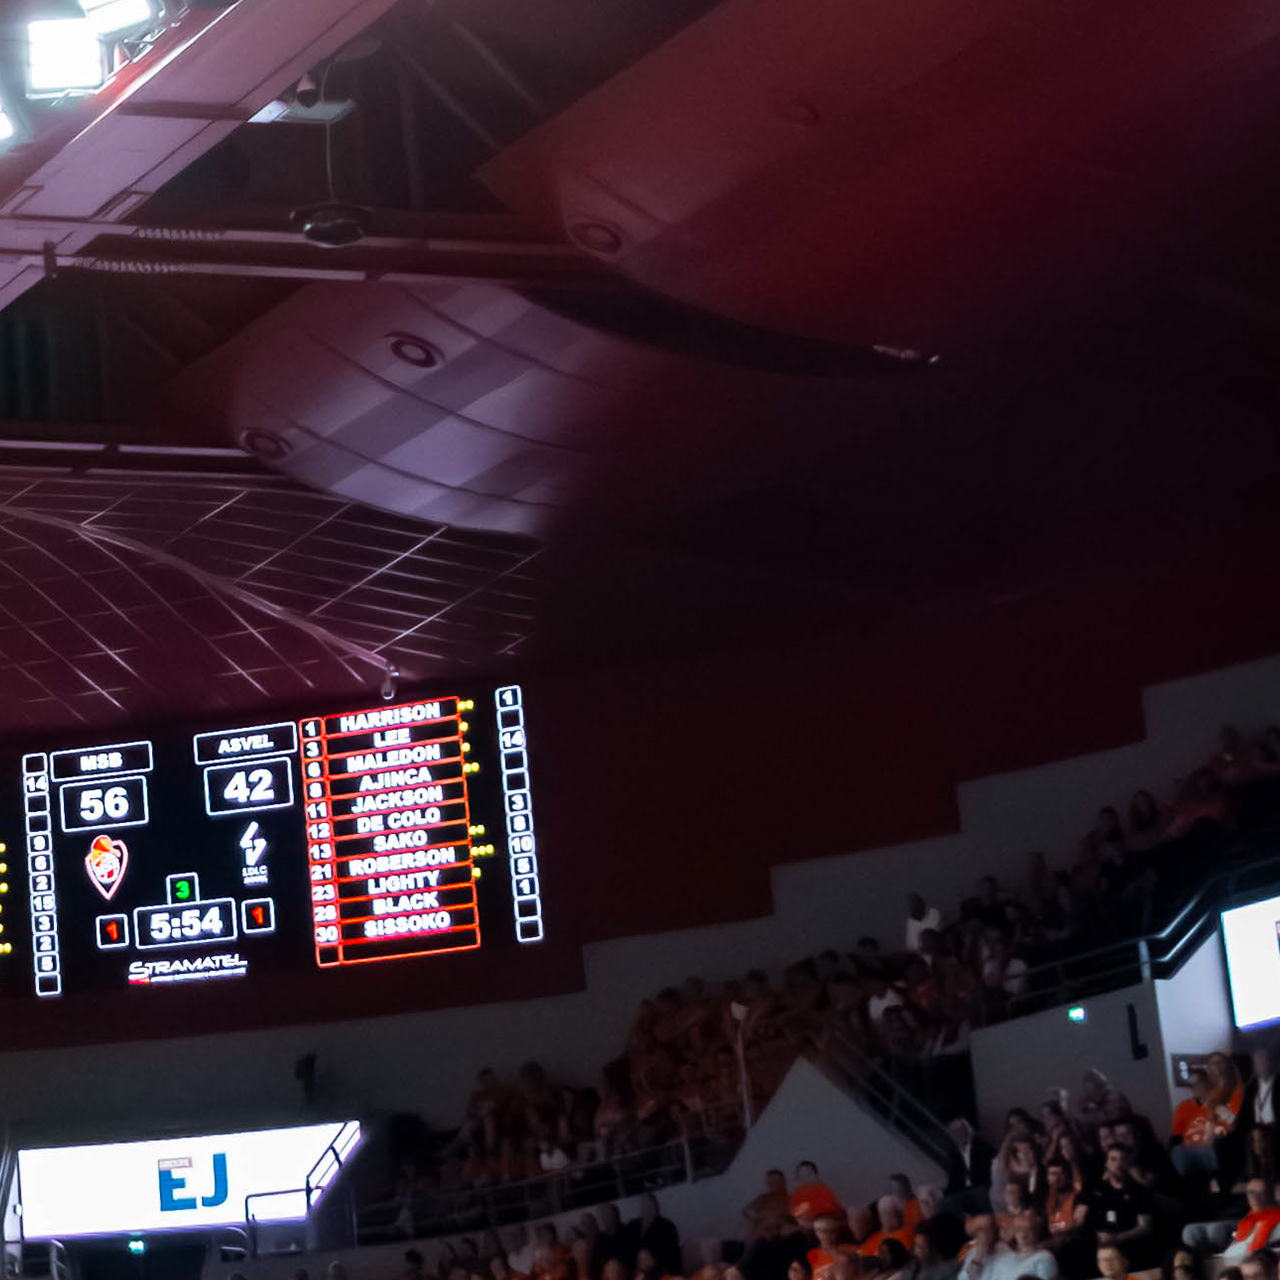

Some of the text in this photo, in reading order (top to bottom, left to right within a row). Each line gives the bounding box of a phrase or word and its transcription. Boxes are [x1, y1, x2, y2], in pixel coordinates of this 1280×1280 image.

[304, 702, 441, 736] 1 HARRISON
[218, 734, 274, 754] ASVEL
[306, 728, 411, 757] 3 LEE
[80, 752, 123, 771] MSB
[347, 744, 441, 772] MALEDON
[224, 769, 275, 803] 42
[359, 766, 432, 791] AJINCA
[80, 787, 129, 821] 56
[307, 785, 443, 818] 11 JACKSON
[308, 807, 441, 839] 12 DE COLO
[310, 830, 428, 859] 13 SAKO
[311, 847, 455, 879] 21 ROBERSON
[176, 881, 190, 899] 3
[313, 870, 440, 900] 23 LIGHTY
[252, 906, 263, 925] 1
[372, 891, 440, 915] BLACK
[106, 921, 118, 940] 1
[150, 907, 223, 939] 5:54
[316, 911, 451, 942] 30 SISSOKO
[128, 954, 248, 979] STRAMATEL
[157, 1152, 229, 1212] EJ
